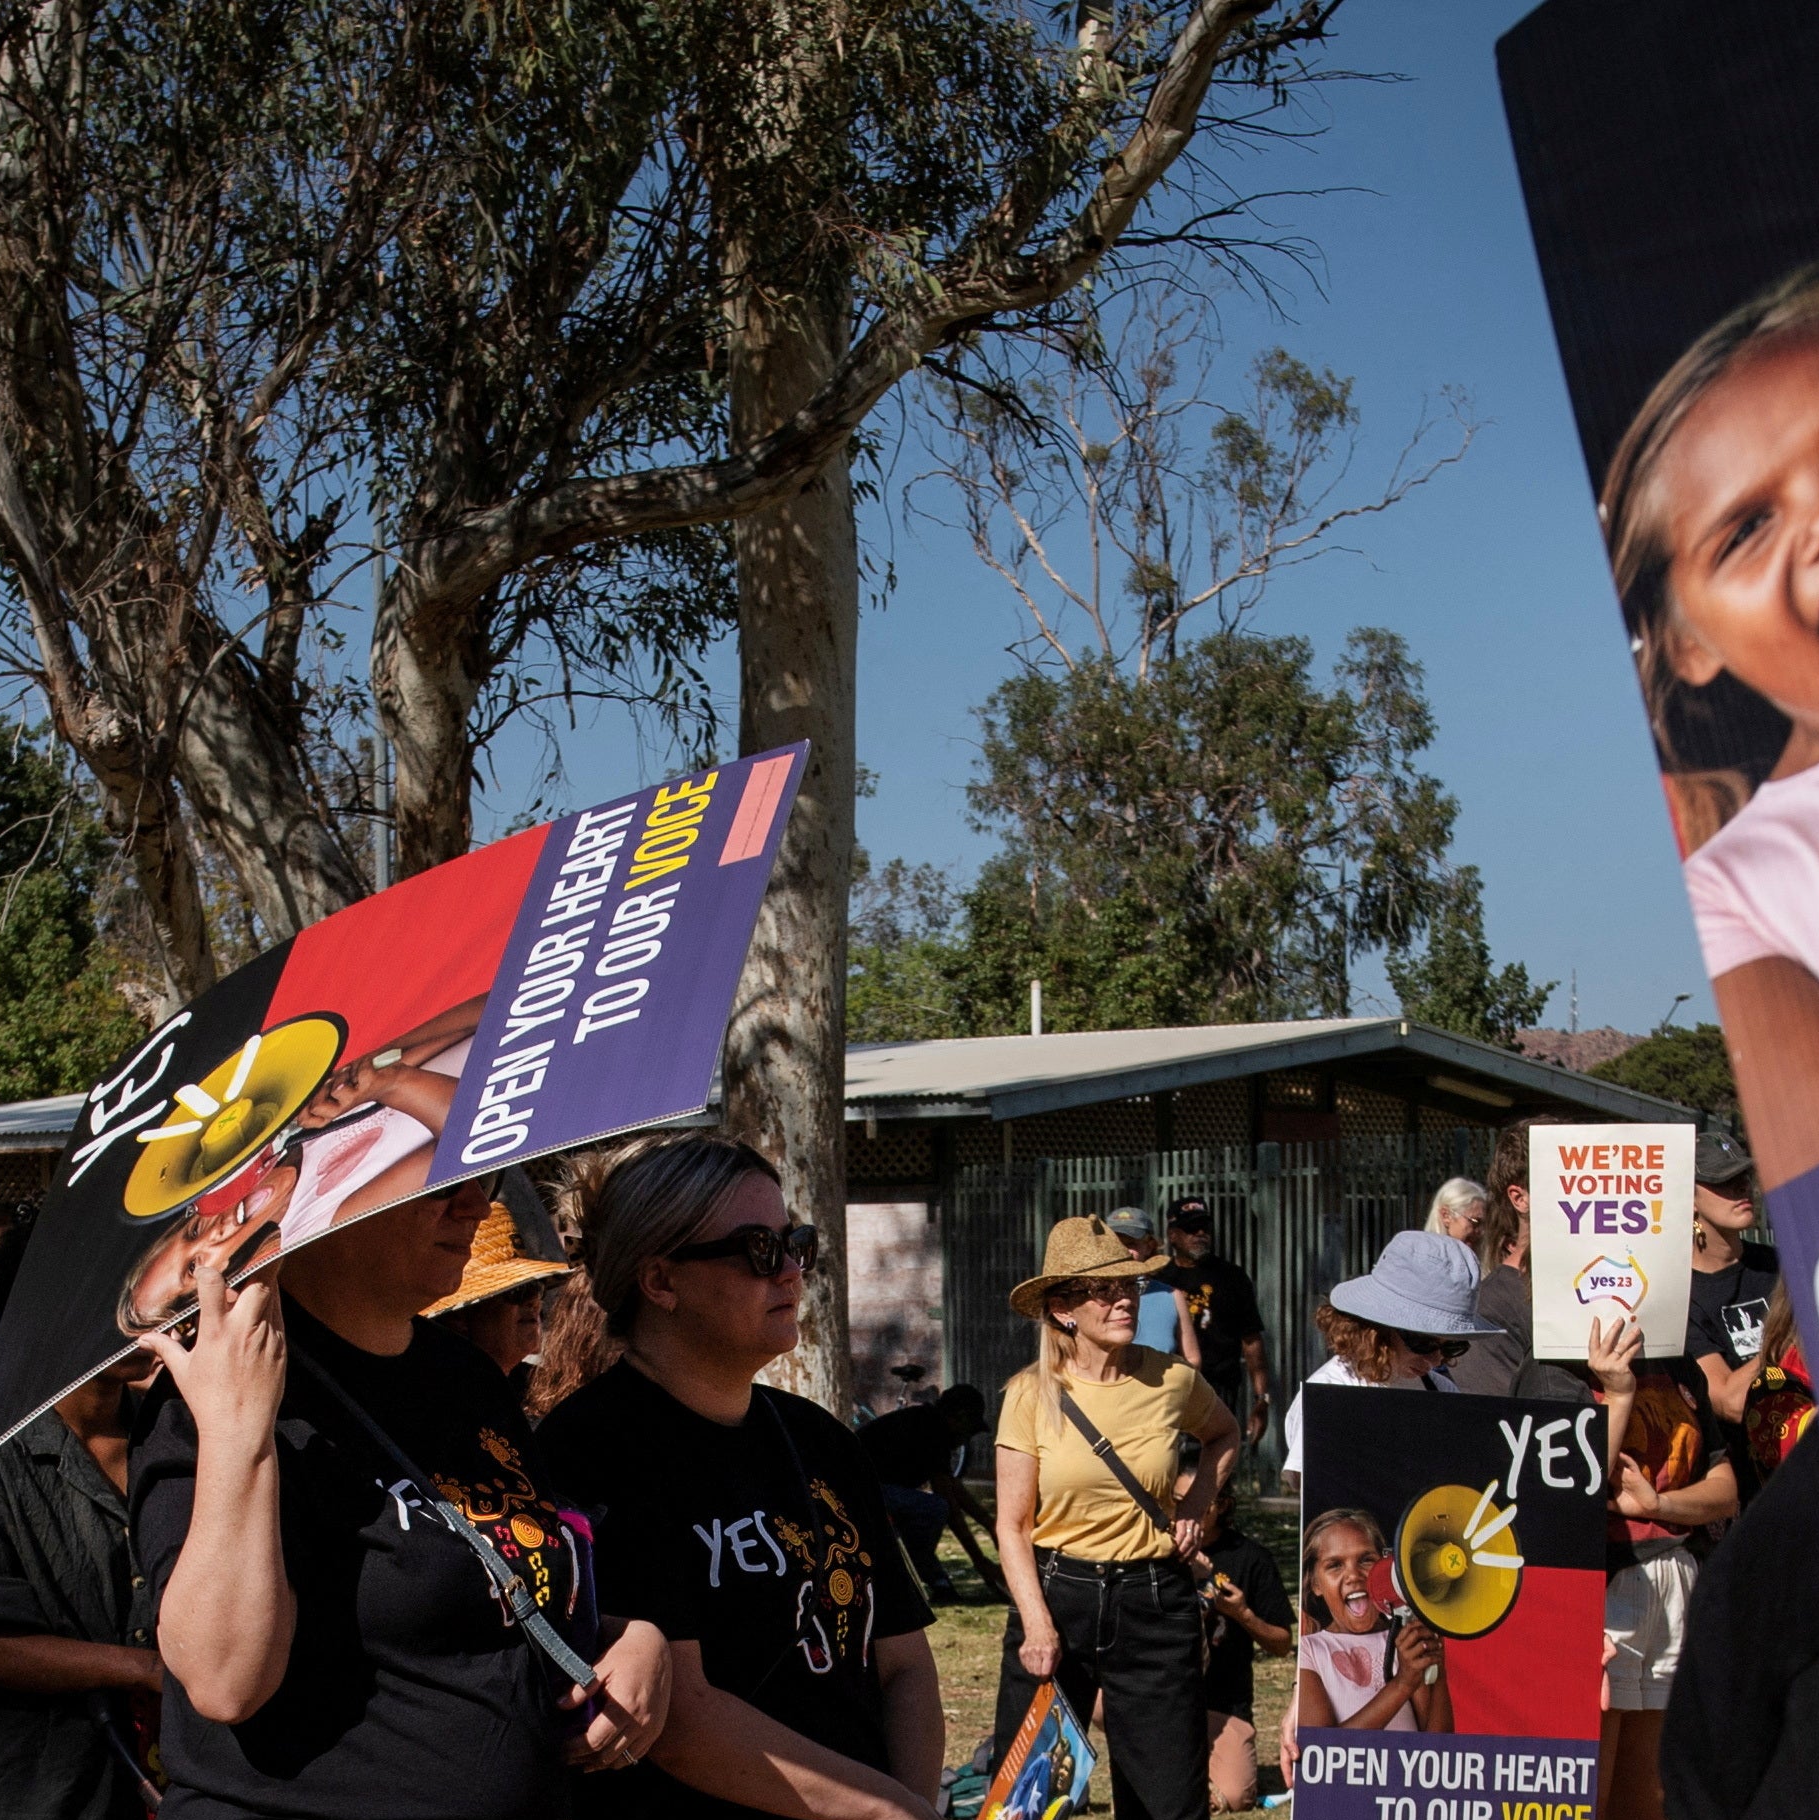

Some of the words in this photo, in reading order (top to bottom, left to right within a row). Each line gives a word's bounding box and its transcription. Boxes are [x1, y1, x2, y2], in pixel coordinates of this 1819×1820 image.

[540, 801, 638, 928] HEART
[623, 771, 720, 891] VOICE
[594, 881, 682, 977] OUR
[498, 918, 596, 1048] YOUR
[572, 977, 651, 1045] TO
[67, 1011, 193, 1188] YES
[460, 1038, 556, 1165] OPEN
[1557, 1144, 1665, 1170] WE'RE
[1559, 1174, 1663, 1195] VOTING
[1557, 1199, 1664, 1235] YES!
[1589, 1275, 1633, 1291] yes23
[1498, 1407, 1602, 1499] YES
[692, 1510, 787, 1588] YES
[1301, 1744, 1389, 1786] OPEN
[1398, 1749, 1485, 1790] YOUR
[1493, 1753, 1595, 1795] HEART
